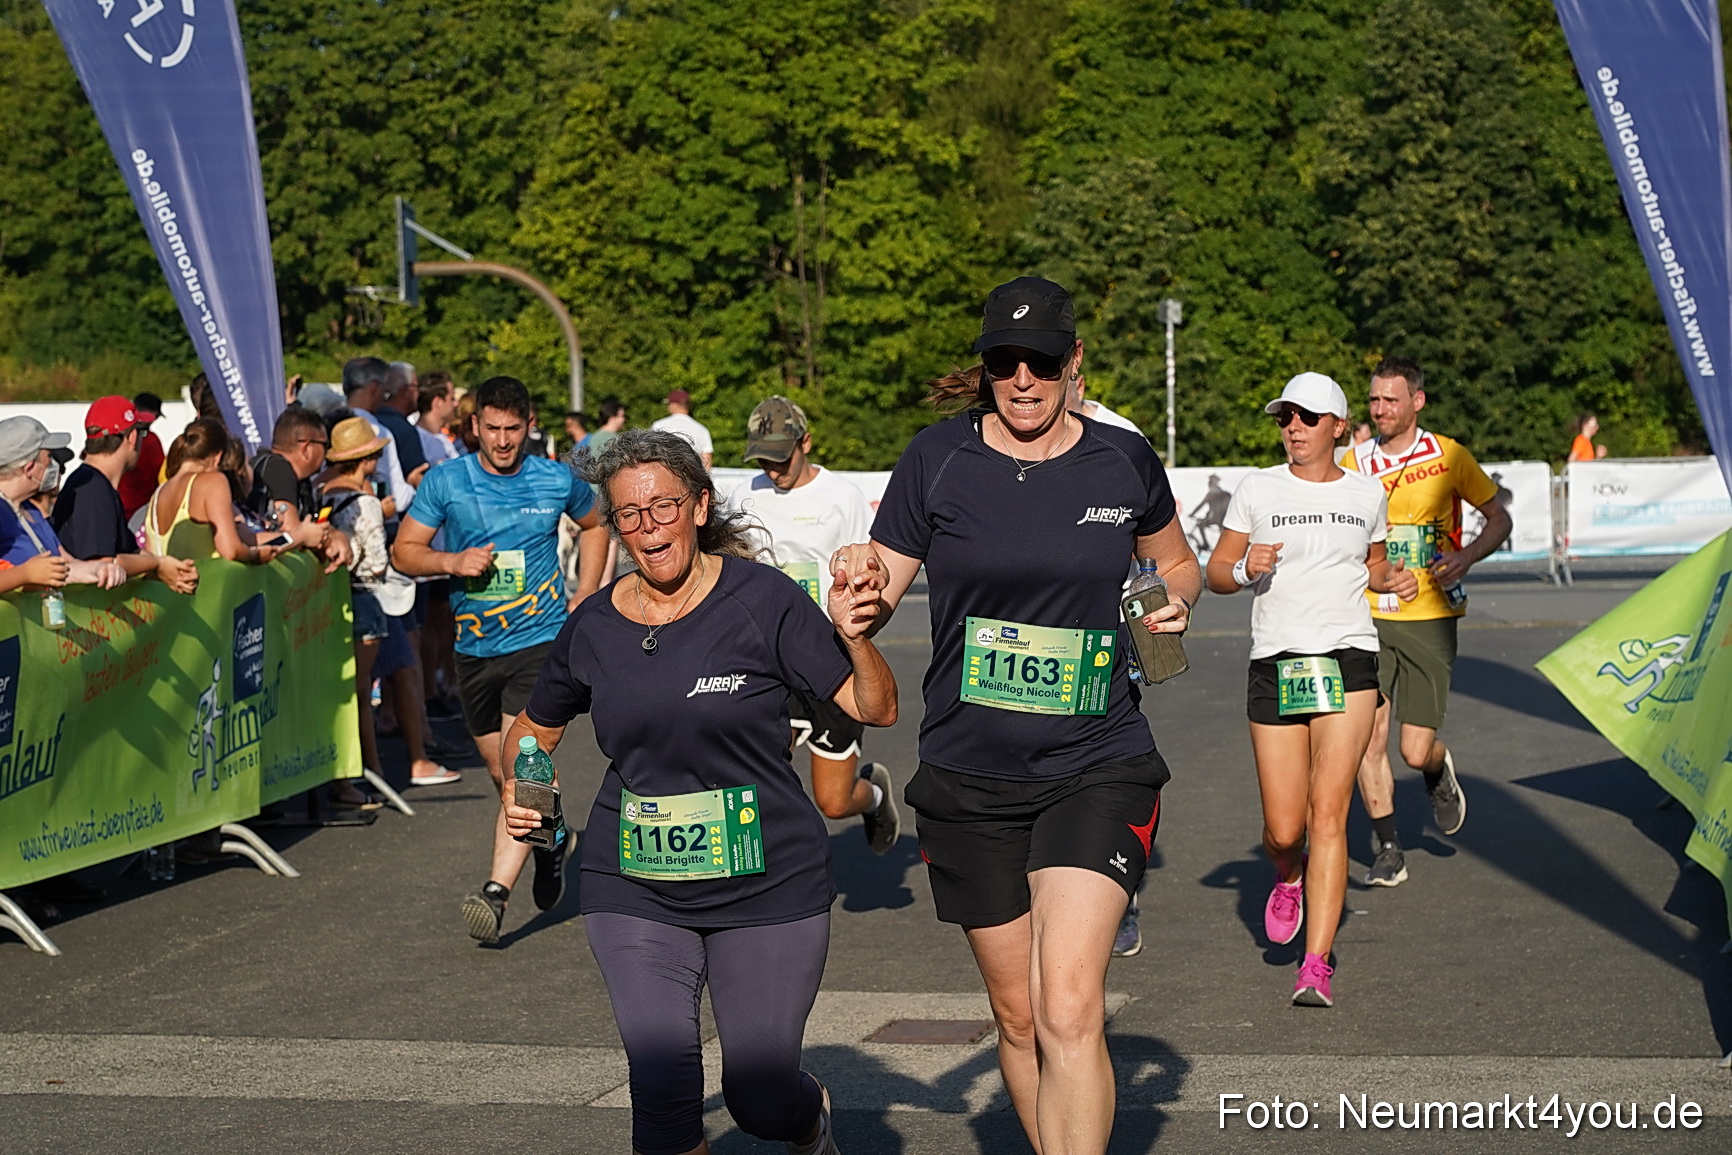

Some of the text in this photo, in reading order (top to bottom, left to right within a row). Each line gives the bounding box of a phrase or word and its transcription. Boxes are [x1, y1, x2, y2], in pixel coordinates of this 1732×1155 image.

[1405, 463, 1450, 484] BÖGL
[1077, 507, 1120, 525] JURA
[1271, 512, 1366, 528] Dream Team
[995, 637, 1030, 646] Firmenlauf
[968, 655, 981, 686] RUN
[984, 649, 1060, 686] 1163
[686, 677, 731, 698] JURA
[978, 678, 1061, 699] Weißflog Nicole
[1060, 663, 1075, 703] 2022
[1288, 676, 1333, 696] 1460
[637, 811, 672, 819] Firmenlauf
[623, 830, 632, 860] RUN
[631, 824, 708, 853] 1162
[710, 825, 724, 866] 2022
[636, 853, 706, 867] Gradl Brigitte
[1109, 858, 1128, 875] erima
